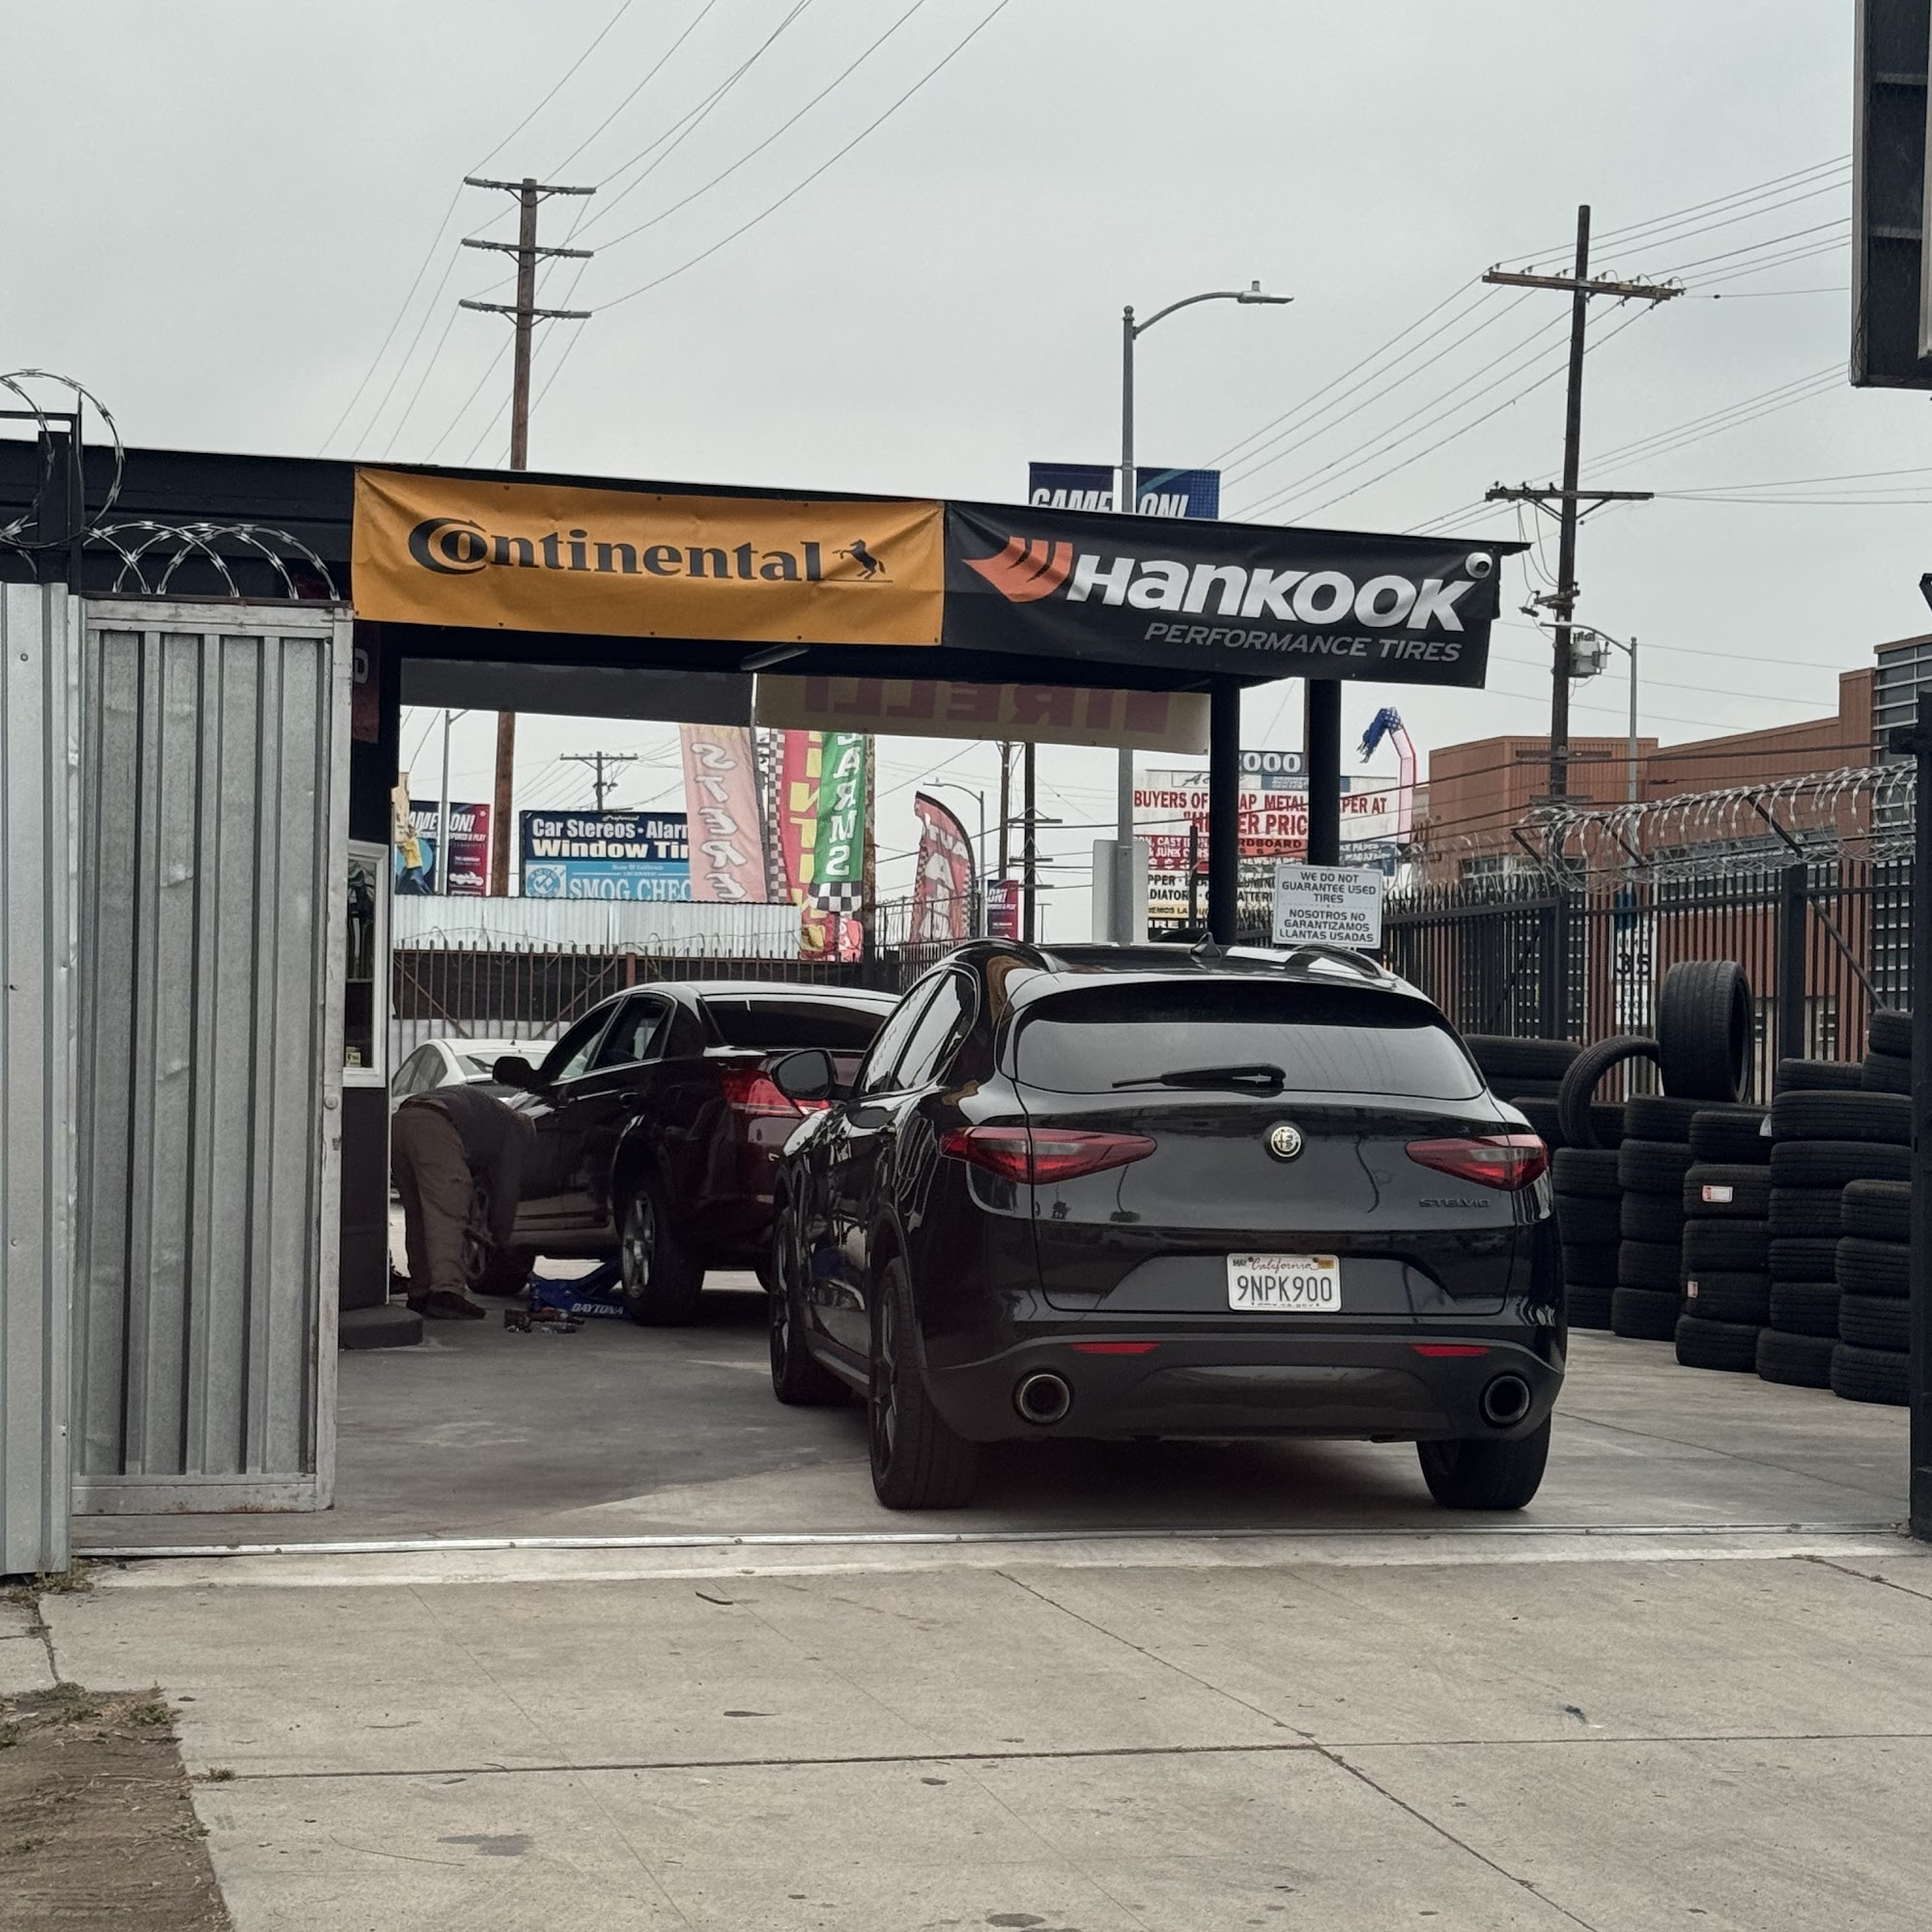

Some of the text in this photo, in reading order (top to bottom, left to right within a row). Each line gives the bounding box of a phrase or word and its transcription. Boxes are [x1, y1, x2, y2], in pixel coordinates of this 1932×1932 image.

[408, 517, 823, 582] Continental
[1145, 622, 1463, 662] PERFORMANCE TIRES
[1239, 753, 1301, 773] 000
[1134, 790, 1187, 808] BUYERS
[1191, 792, 1208, 809] OF
[1264, 794, 1308, 812] METAL
[1340, 798, 1368, 813] PER
[1372, 798, 1387, 813] AT
[409, 811, 475, 832] AME ON!
[532, 819, 564, 838] Car
[567, 819, 636, 838] Stereos
[1265, 814, 1308, 836] PRIC
[532, 839, 648, 859] Window
[1238, 838, 1302, 848] RDBOARD
[1148, 874, 1175, 886] PPER
[1300, 871, 1359, 883] WE DO NOT
[570, 877, 632, 899] SMOG
[637, 879, 691, 900] CHEC
[1282, 881, 1345, 894] GUARANTEE
[1348, 885, 1376, 895] USED
[1314, 893, 1344, 903] TIRES
[1290, 909, 1365, 922] NOSOTROS NO
[1284, 919, 1370, 931] GARANTIZAMOS
[1279, 928, 1374, 942] LLANTAS USADAS
[1419, 1198, 1491, 1208] STELVIO
[1251, 1257, 1319, 1274] California
[1237, 1275, 1332, 1301] 9NPK900
[571, 1303, 624, 1314] DAYTONA
